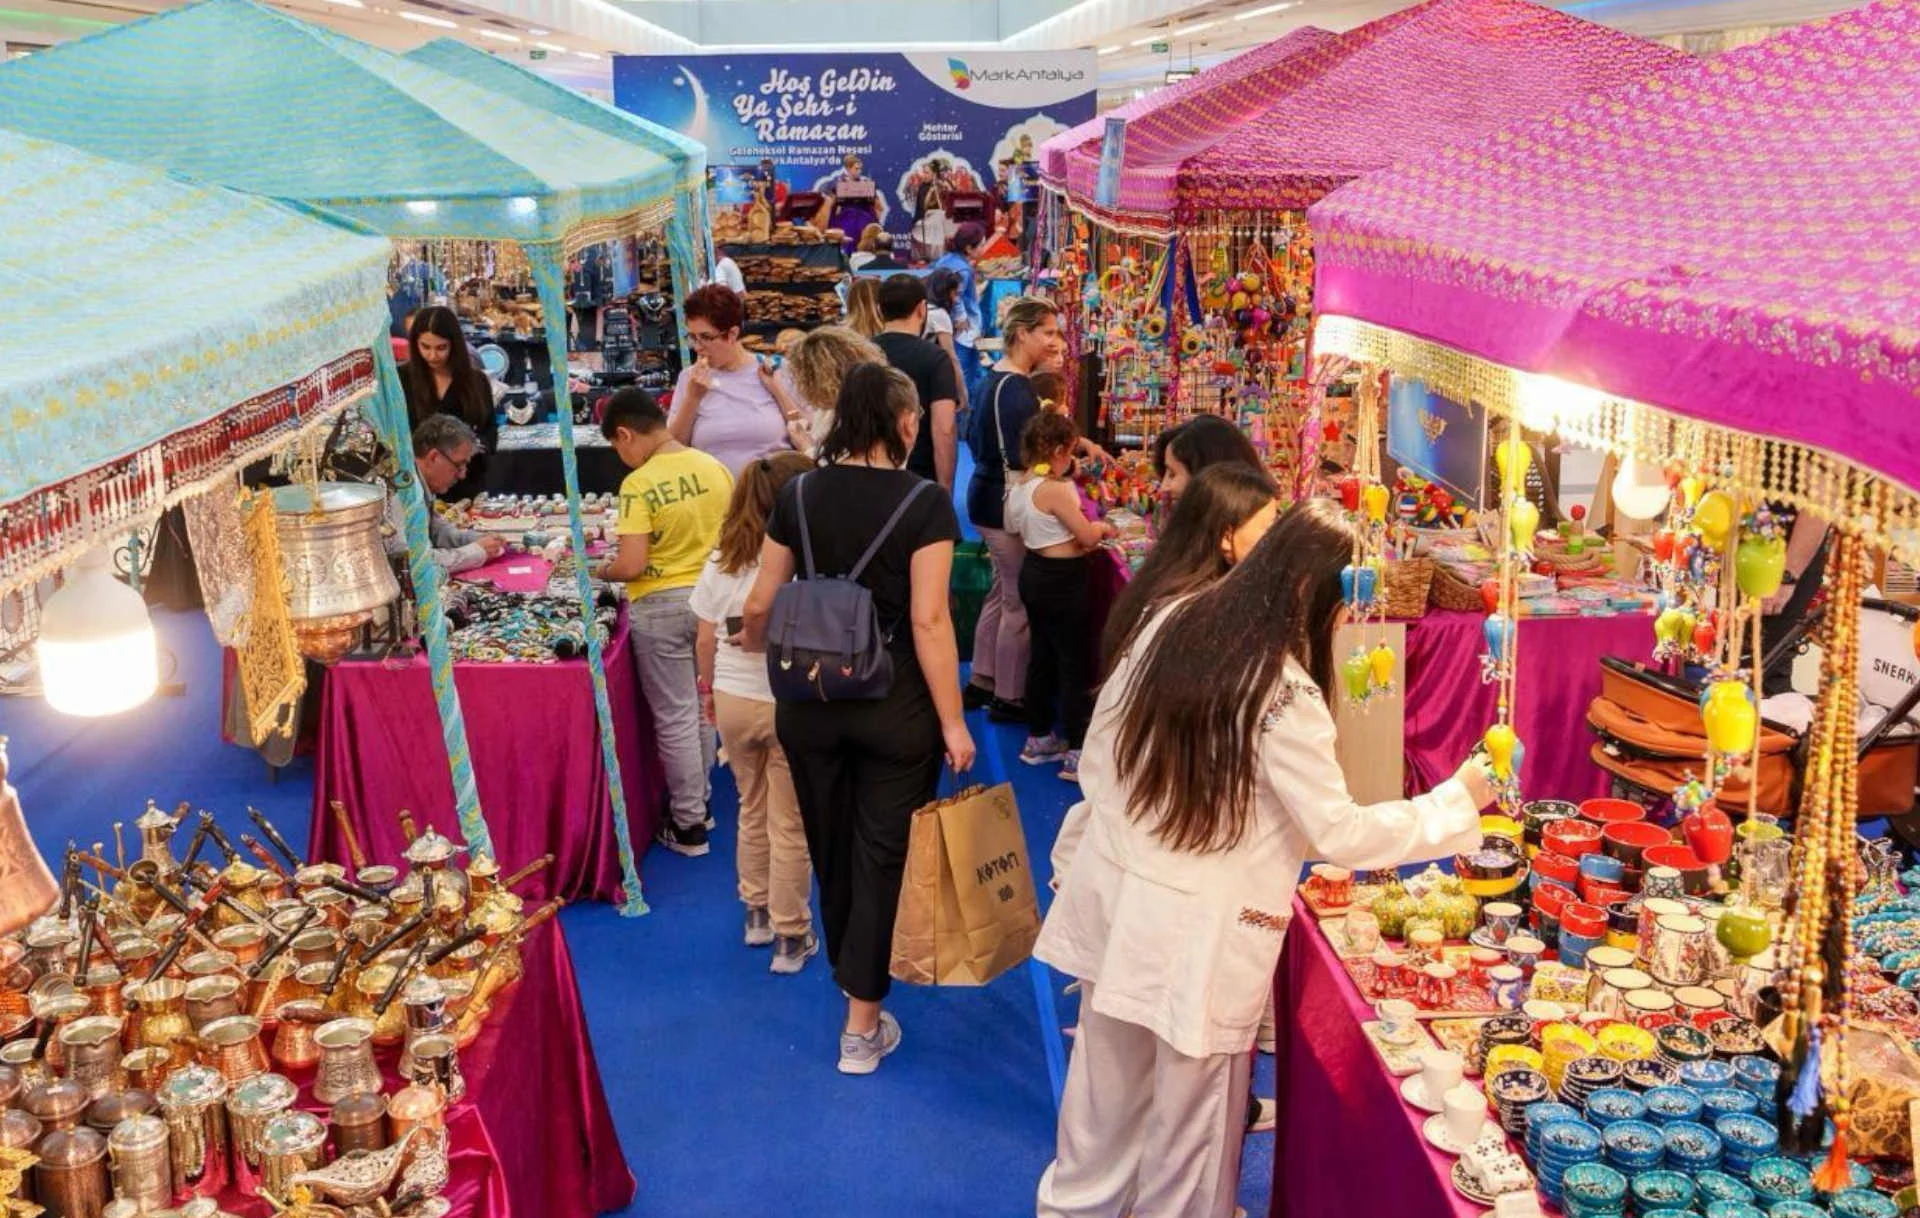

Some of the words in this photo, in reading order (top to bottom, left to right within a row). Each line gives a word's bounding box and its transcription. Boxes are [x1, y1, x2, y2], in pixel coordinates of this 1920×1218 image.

[760, 67, 811, 97] Hoş
[820, 67, 896, 98] Geldin
[969, 68, 1084, 82] MarkAntalya
[732, 93, 771, 124] Ya
[776, 92, 857, 125] Şehr-i
[754, 117, 868, 142] Ramazan
[788, 144, 836, 155] Ramazan
